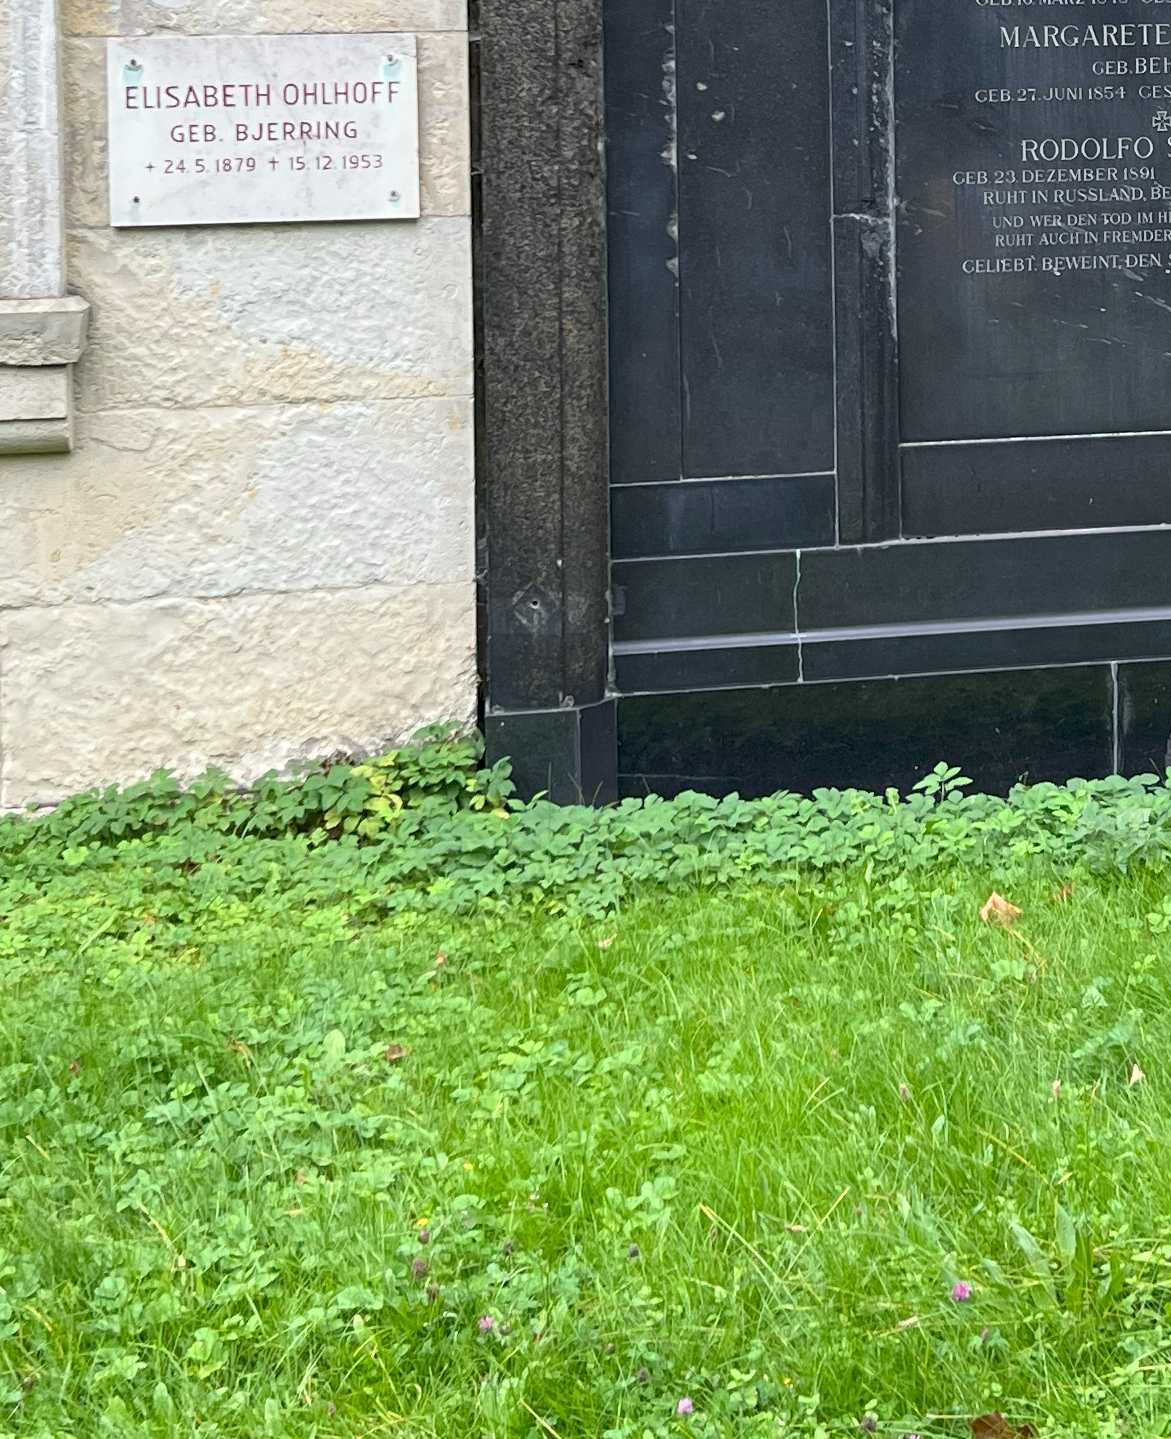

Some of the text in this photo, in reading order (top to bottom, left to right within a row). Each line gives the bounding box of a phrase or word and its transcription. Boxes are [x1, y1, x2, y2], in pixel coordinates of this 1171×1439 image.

[1000, 23, 1171, 48] MARGARETE
[1092, 60, 1133, 75] GEB.
[125, 81, 401, 109] ELISABETH OHLHOFF
[975, 88, 1015, 102] GEB.
[1043, 87, 1083, 101] JUNI
[1088, 86, 1127, 100] 1854
[170, 121, 358, 143] GEB. BJERRING
[1021, 136, 1154, 162] RODOLFO
[1022, 167, 1119, 183] DEZEMBER
[1123, 166, 1156, 181] 1891
[983, 190, 1028, 205] RUHT
[1032, 189, 1049, 204] IN
[992, 215, 1024, 229] UND
[1030, 214, 1063, 228] WER
[1067, 213, 1098, 226] DEN
[1101, 212, 1132, 226] TOD
[1137, 211, 1154, 225] IM
[995, 233, 1035, 247] RUHT
[1039, 232, 1080, 246] AUCH
[1083, 231, 1099, 244] IN
[1126, 253, 1162, 269] DEN
